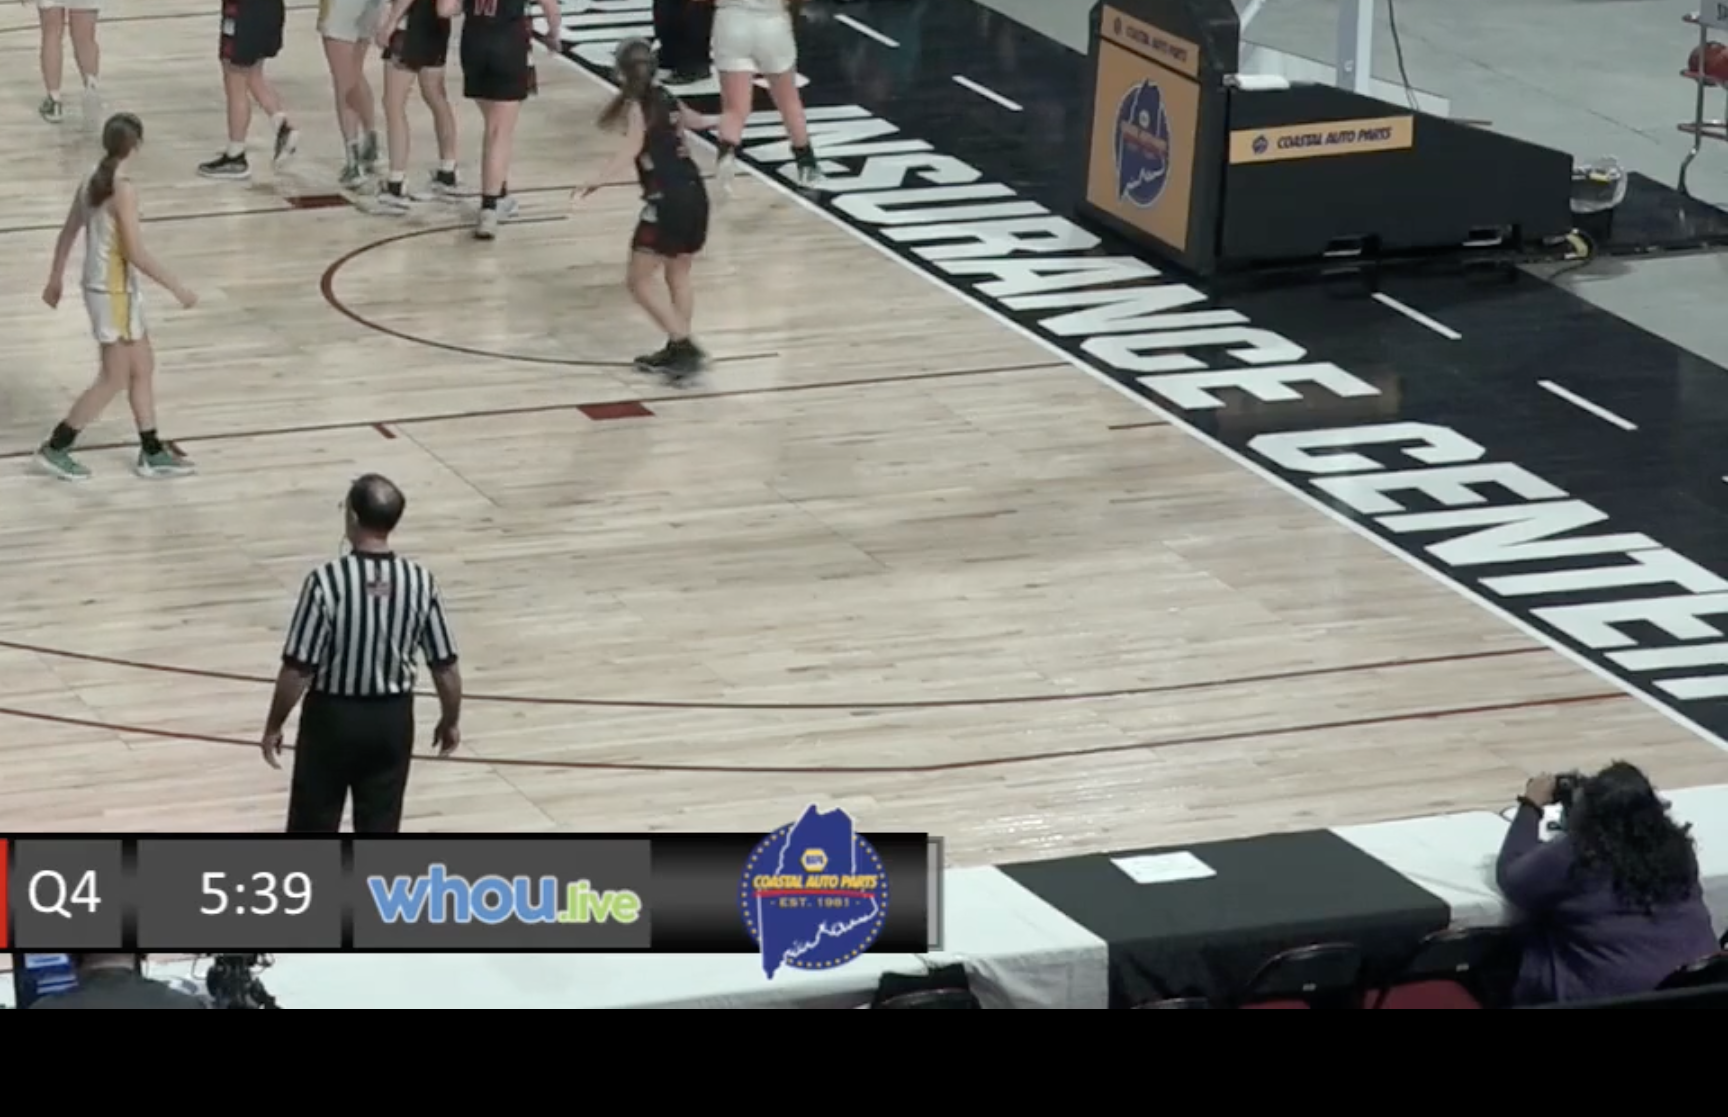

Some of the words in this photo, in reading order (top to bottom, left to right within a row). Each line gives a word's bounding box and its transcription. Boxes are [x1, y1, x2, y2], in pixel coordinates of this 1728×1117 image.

[1278, 135, 1322, 149] COASTAL
[1324, 132, 1356, 146] AUTO
[1357, 127, 1393, 142] PARTS
